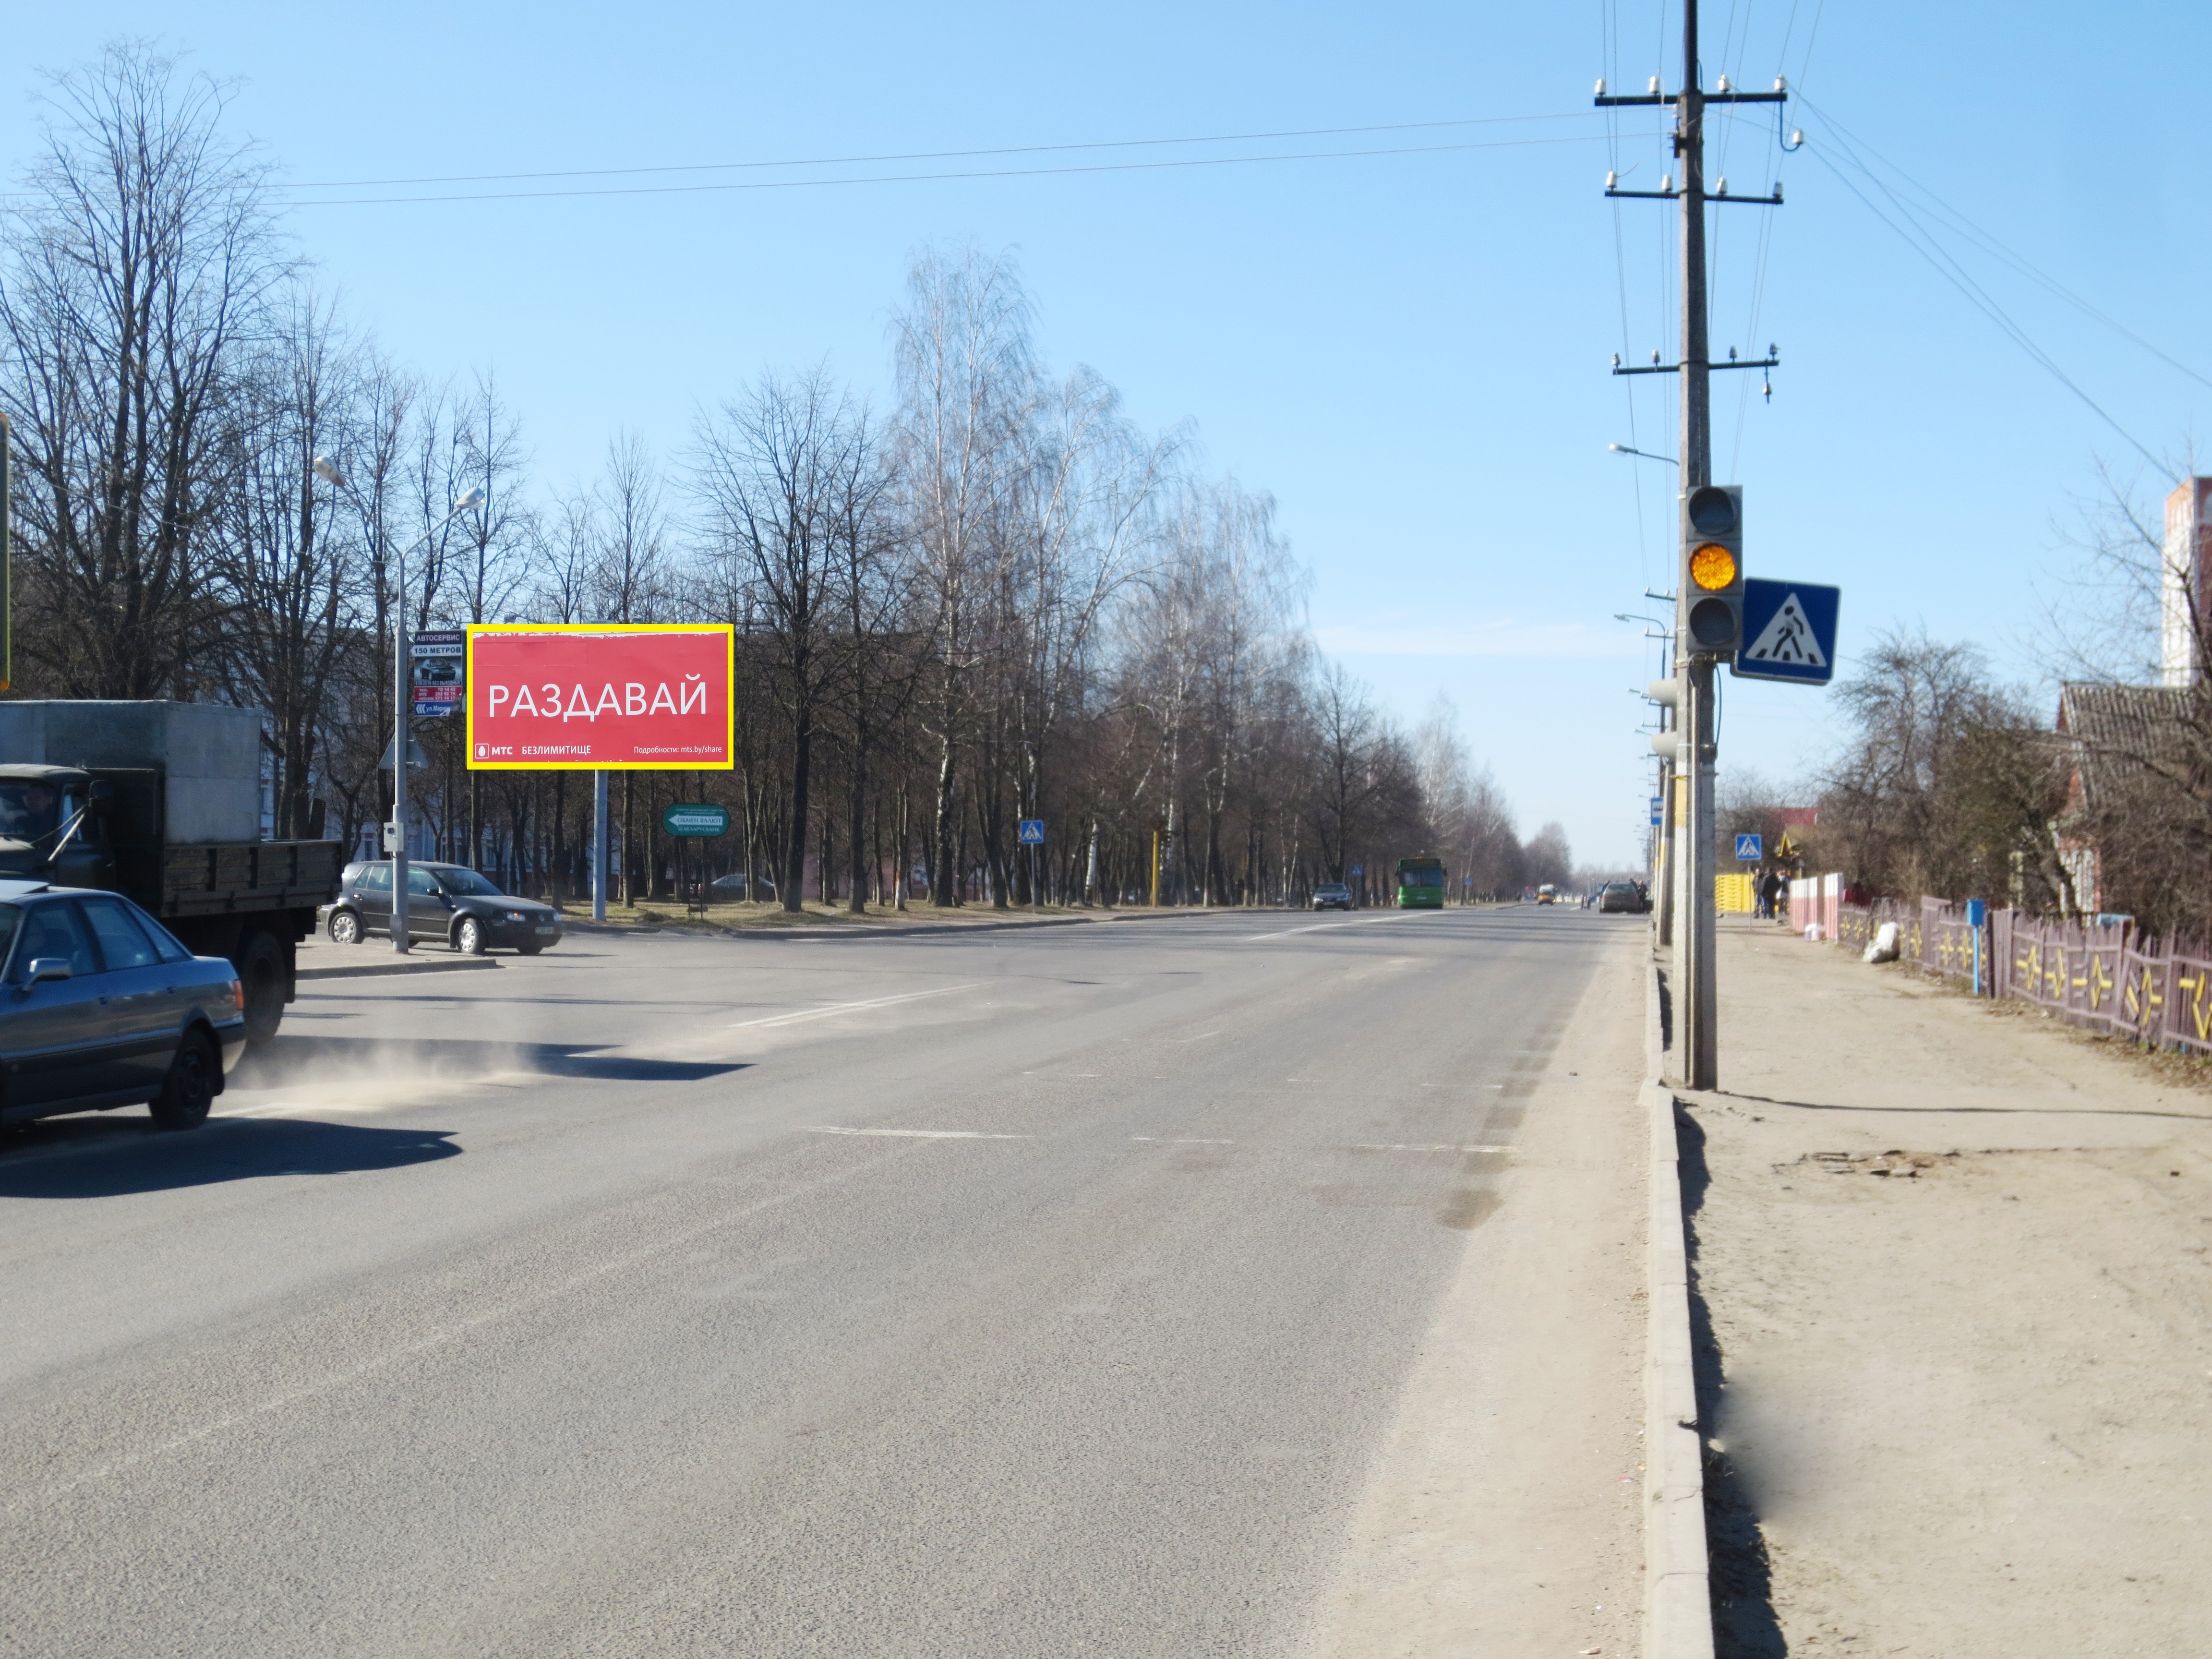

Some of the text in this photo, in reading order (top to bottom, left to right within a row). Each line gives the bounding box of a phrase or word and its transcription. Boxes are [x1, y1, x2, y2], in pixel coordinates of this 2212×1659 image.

[490, 673, 706, 722] РАЗДАВАЙ
[492, 745, 591, 756] МТС БЕЗЛИМИТИЩЕ
[634, 745, 722, 755] Подробности: mts.by/share
